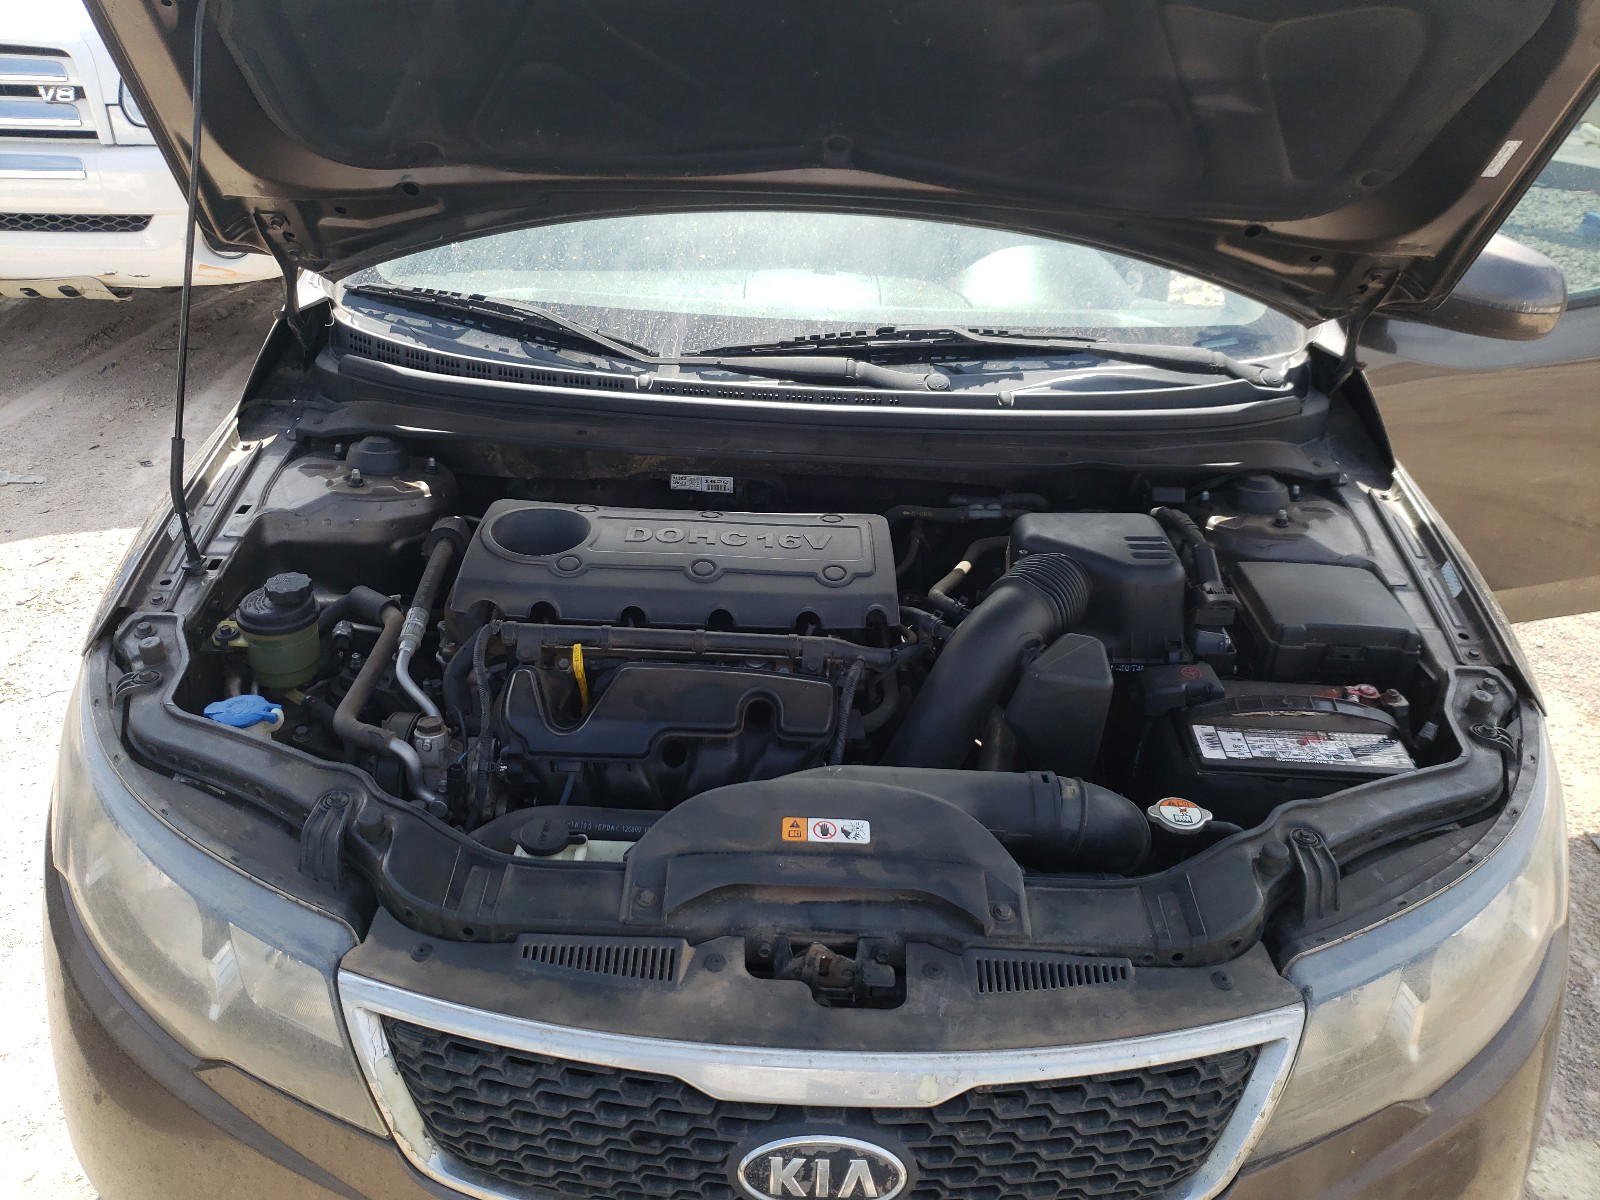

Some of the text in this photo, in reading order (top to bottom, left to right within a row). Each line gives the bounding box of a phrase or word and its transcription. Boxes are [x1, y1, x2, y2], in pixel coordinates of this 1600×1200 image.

[37, 85, 75, 103] V8
[624, 526, 833, 550] DOHC 16V
[769, 1157, 880, 1198] KIA
